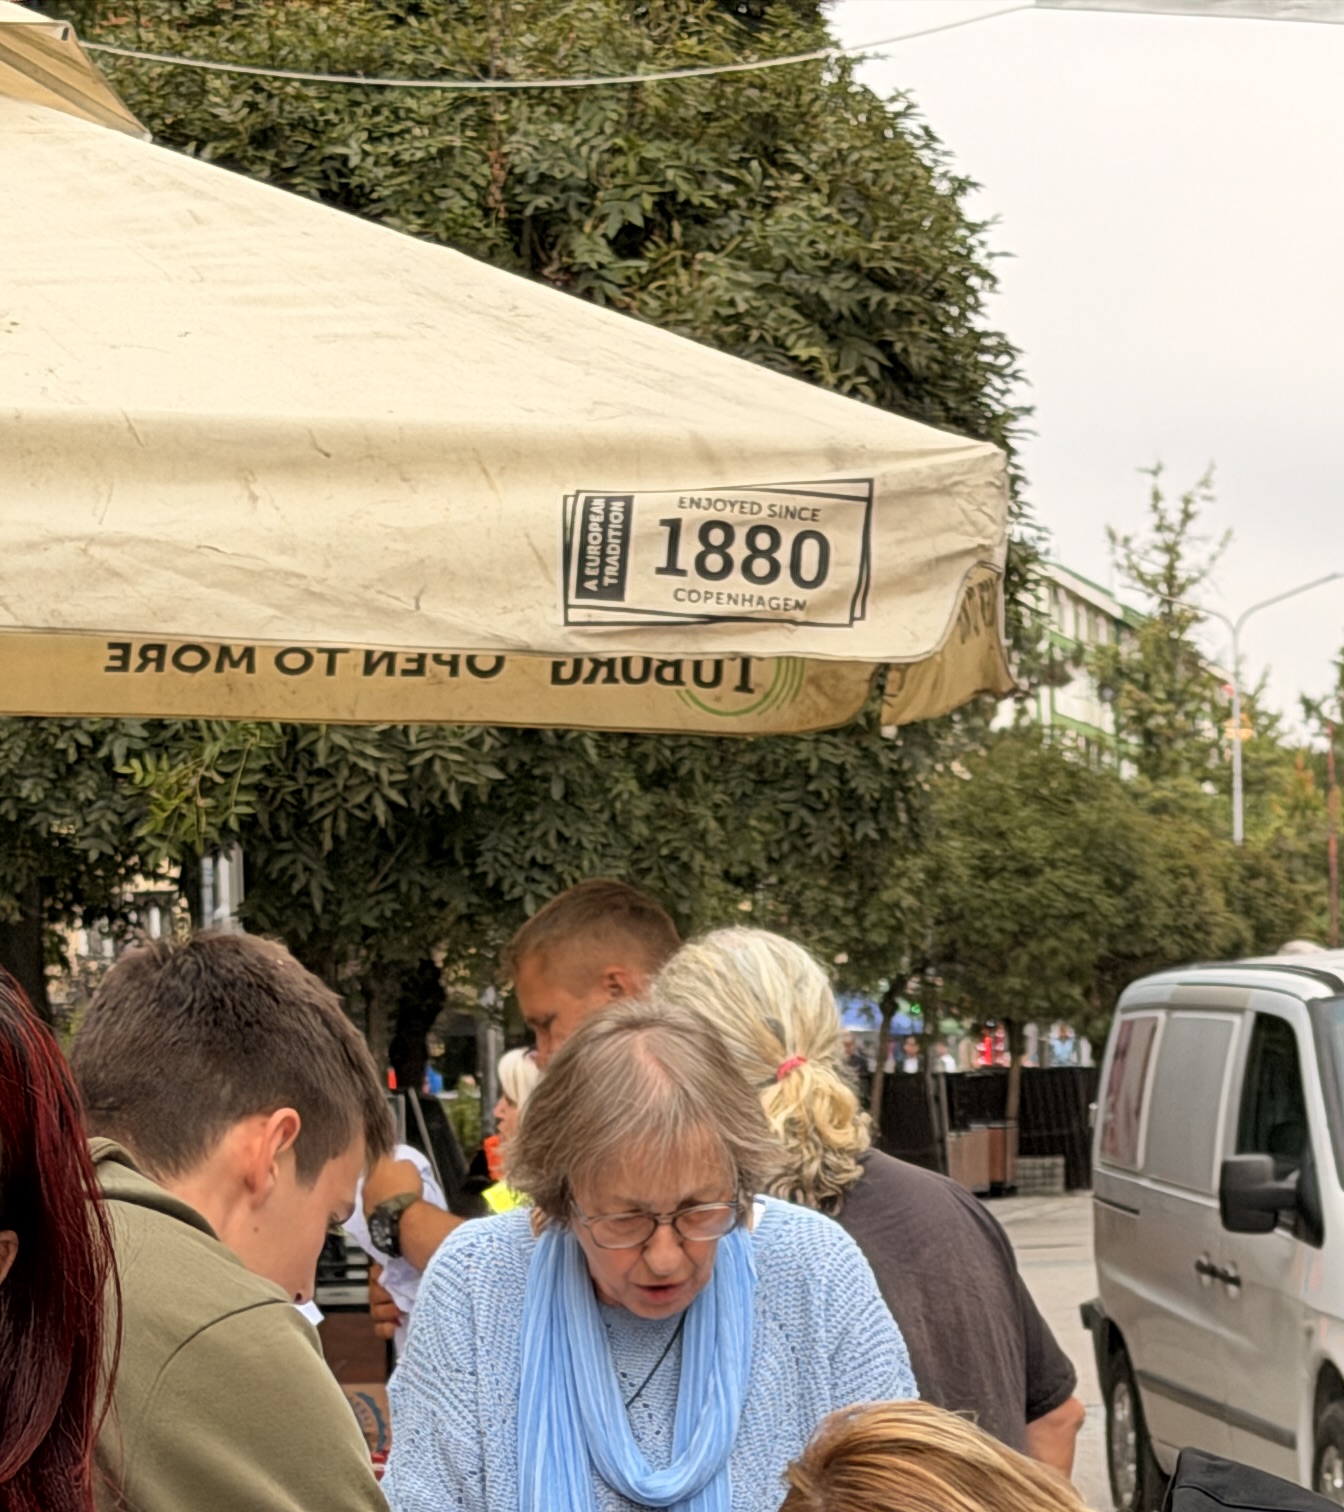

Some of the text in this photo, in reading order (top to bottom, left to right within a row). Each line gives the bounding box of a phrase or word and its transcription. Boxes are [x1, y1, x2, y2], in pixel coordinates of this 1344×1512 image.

[585, 498, 606, 577] EUROPEAN
[603, 500, 626, 588] TRADITION
[677, 496, 822, 522] ENJOYED SINCE
[655, 517, 831, 590] 1880
[672, 588, 808, 612] COPENHAGEN
